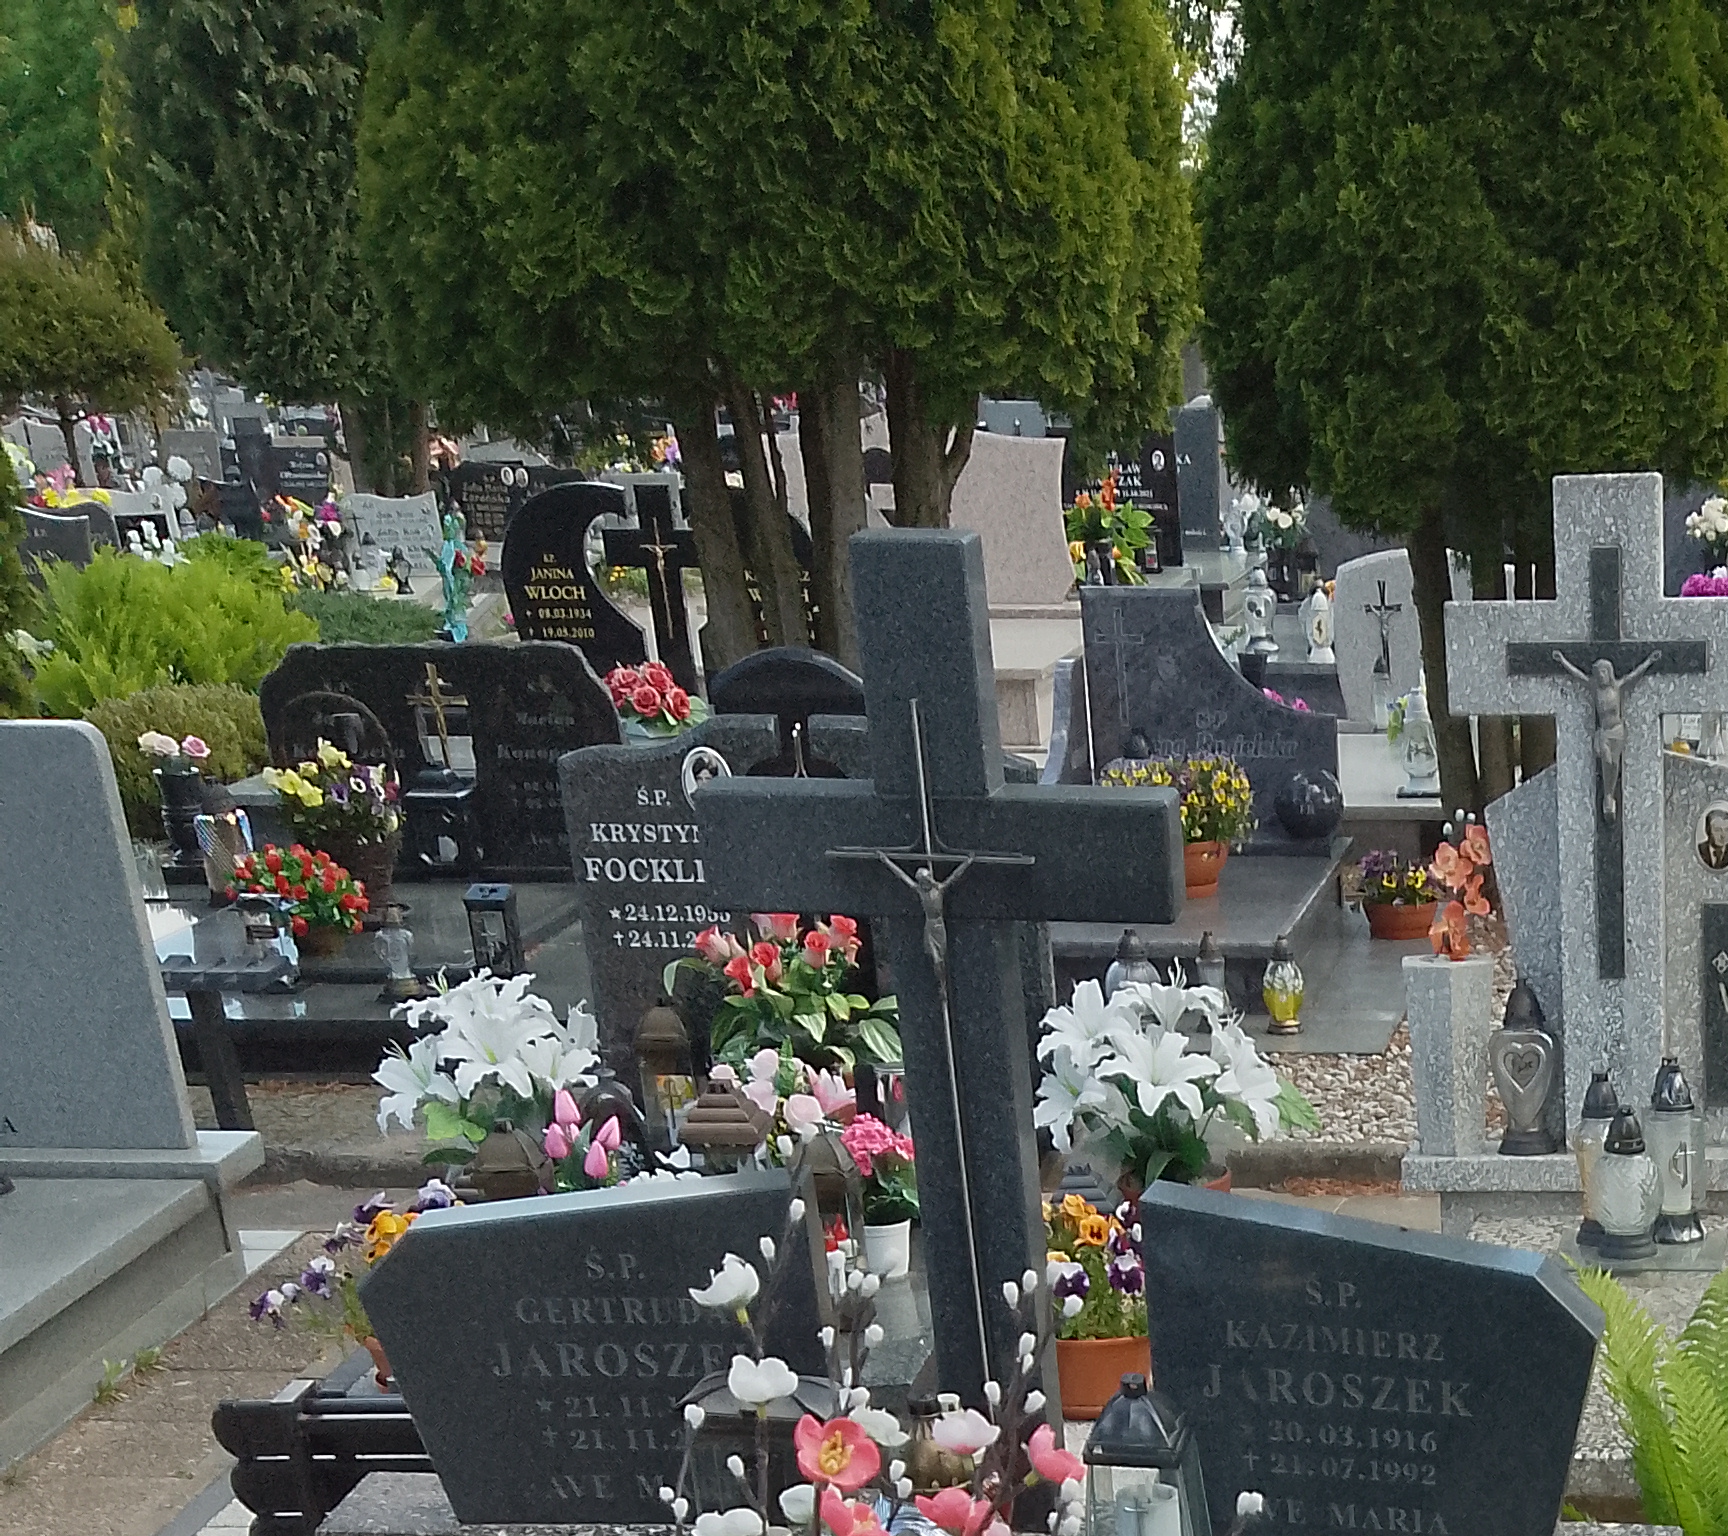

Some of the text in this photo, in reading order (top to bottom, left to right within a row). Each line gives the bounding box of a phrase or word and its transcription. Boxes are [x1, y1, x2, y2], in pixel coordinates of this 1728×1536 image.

[530, 566, 575, 582] JANINA
[1226, 1319, 1445, 1361] KAZIMIERZ
[490, 1341, 748, 1378] JAROSZE
[1203, 1363, 1473, 1417] JAROSZEK
[1270, 1452, 1437, 1486] 21.07.1992
[1328, 1500, 1450, 1536] MARIA
